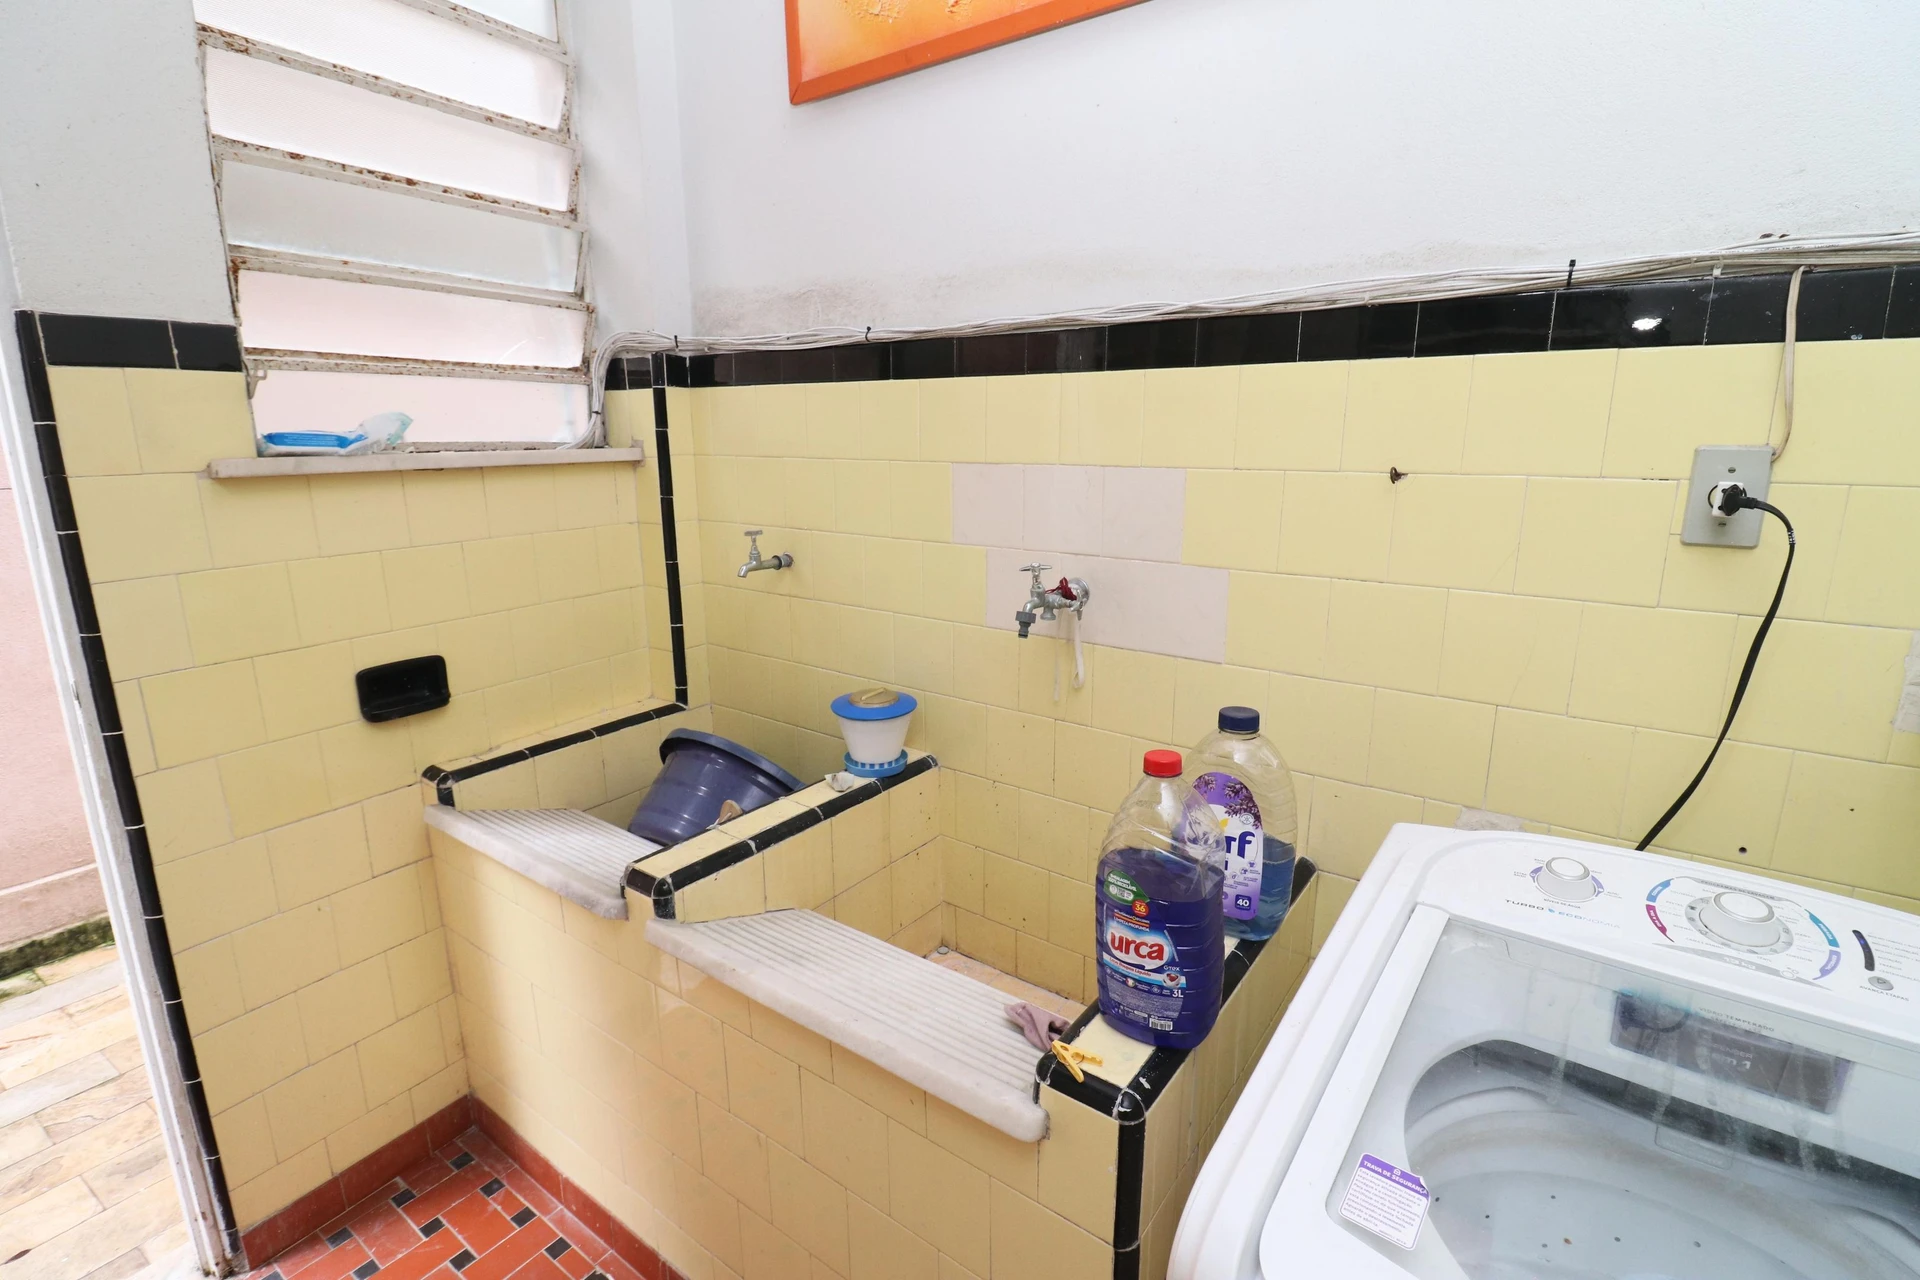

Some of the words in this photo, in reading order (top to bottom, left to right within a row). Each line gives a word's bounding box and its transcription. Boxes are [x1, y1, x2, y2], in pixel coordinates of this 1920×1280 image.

[1135, 903, 1146, 913] 36
[1237, 898, 1250, 907] 40
[1505, 899, 1544, 911] TURBO
[1558, 911, 1621, 929] ECONOMIA
[1111, 931, 1165, 961] urca
[1172, 989, 1184, 998] 3L
[1885, 992, 1910, 1001] ETAPAS
[1699, 1007, 1724, 1018] VIDRO
[1725, 1014, 1775, 1032] TEMPERADO
[1363, 1161, 1382, 1172] TRAVA
[1390, 1174, 1428, 1195] SEGURANÇA
